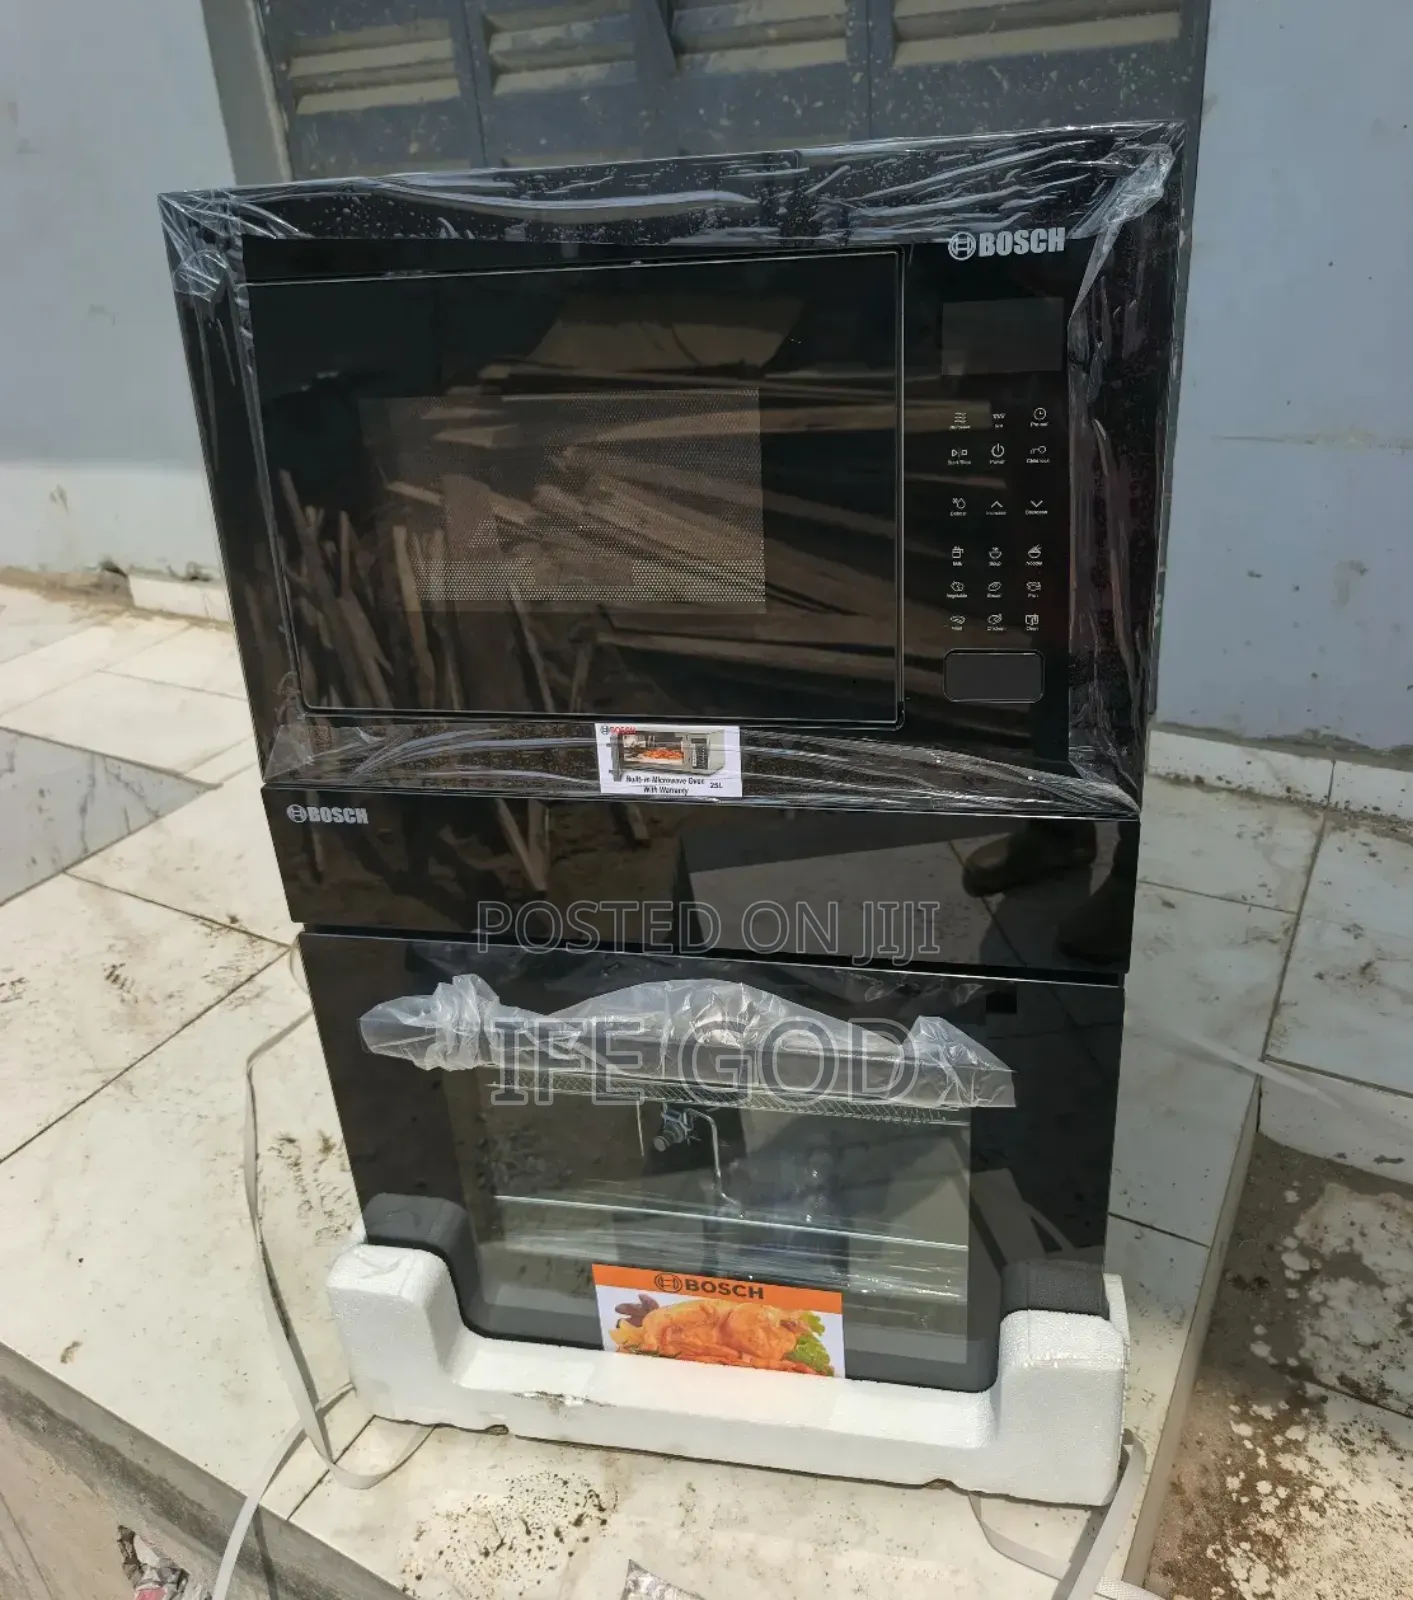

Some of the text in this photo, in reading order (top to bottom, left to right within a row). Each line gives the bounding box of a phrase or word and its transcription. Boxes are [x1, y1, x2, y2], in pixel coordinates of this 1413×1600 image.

[978, 227, 1066, 257] BOSCH
[306, 806, 369, 824] BOSCH
[685, 1278, 764, 1299] BOSCH
